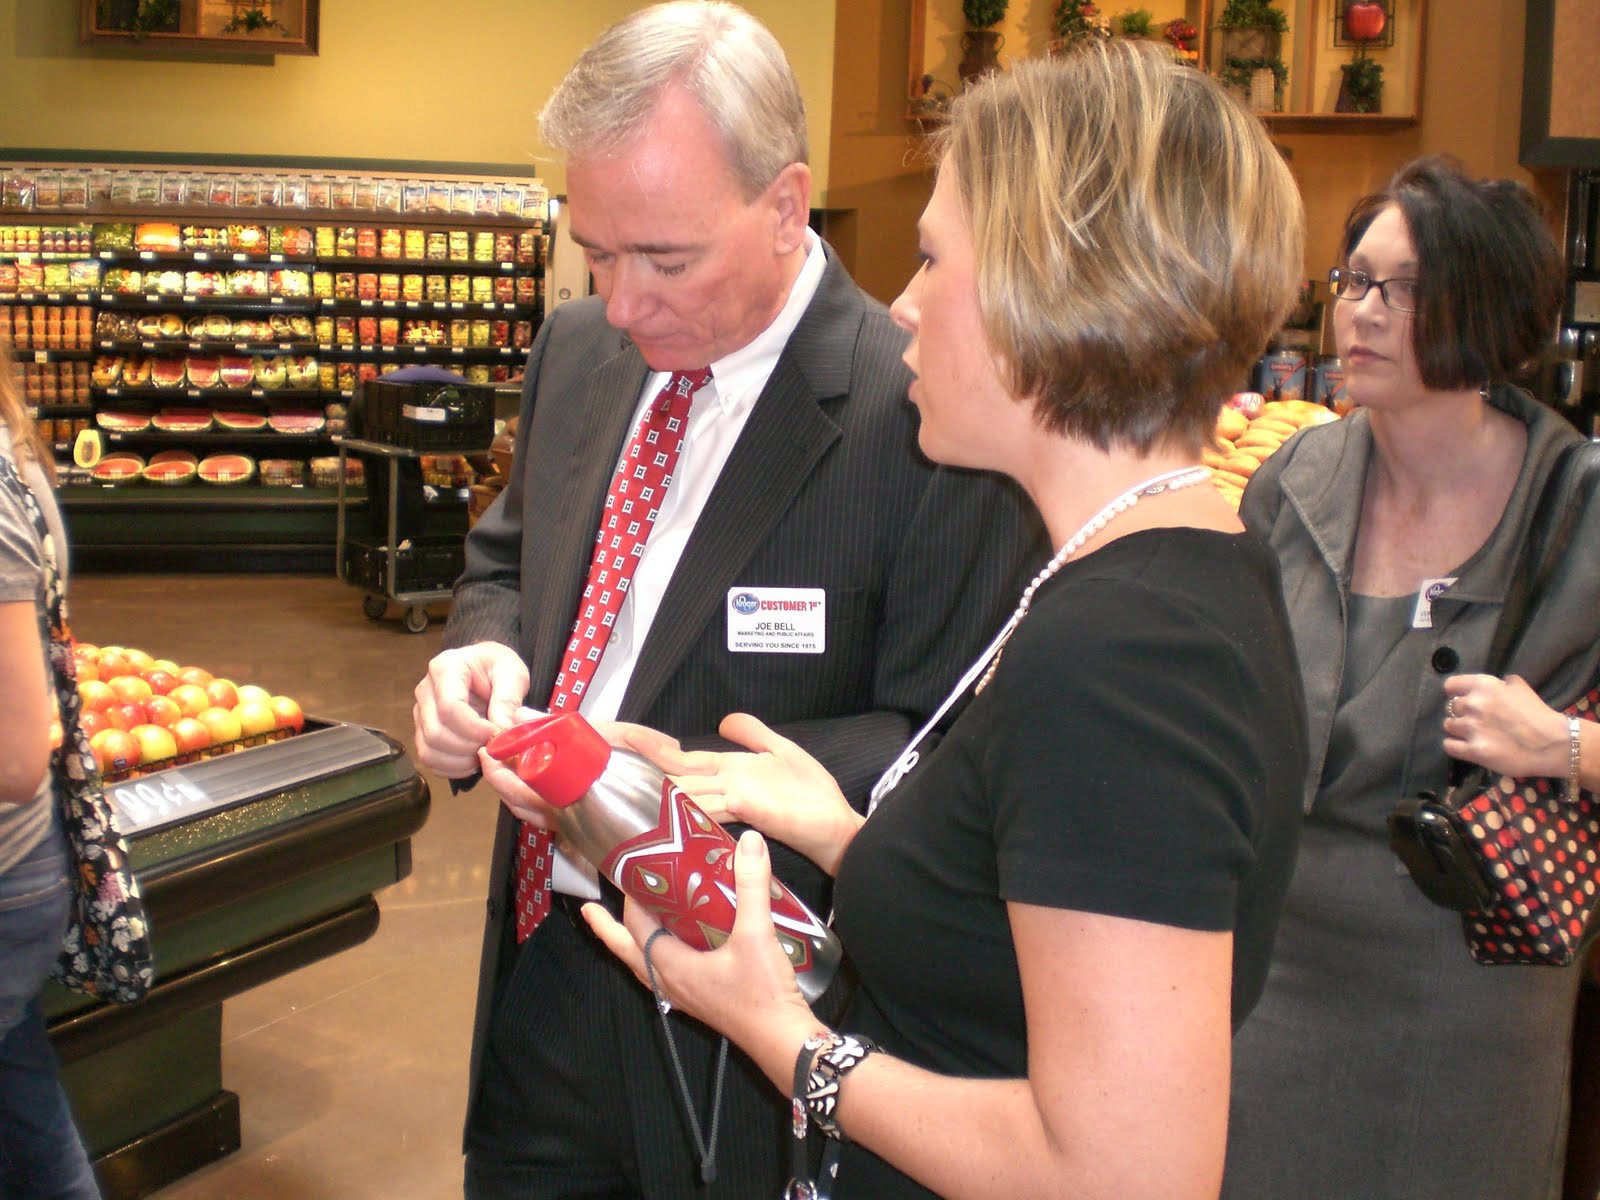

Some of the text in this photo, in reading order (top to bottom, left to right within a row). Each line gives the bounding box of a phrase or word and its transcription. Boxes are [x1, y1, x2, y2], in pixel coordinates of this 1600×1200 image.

[735, 595, 757, 611] Kroger
[761, 600, 807, 611] CUSTOMER
[755, 622, 796, 631] JOE BELL
